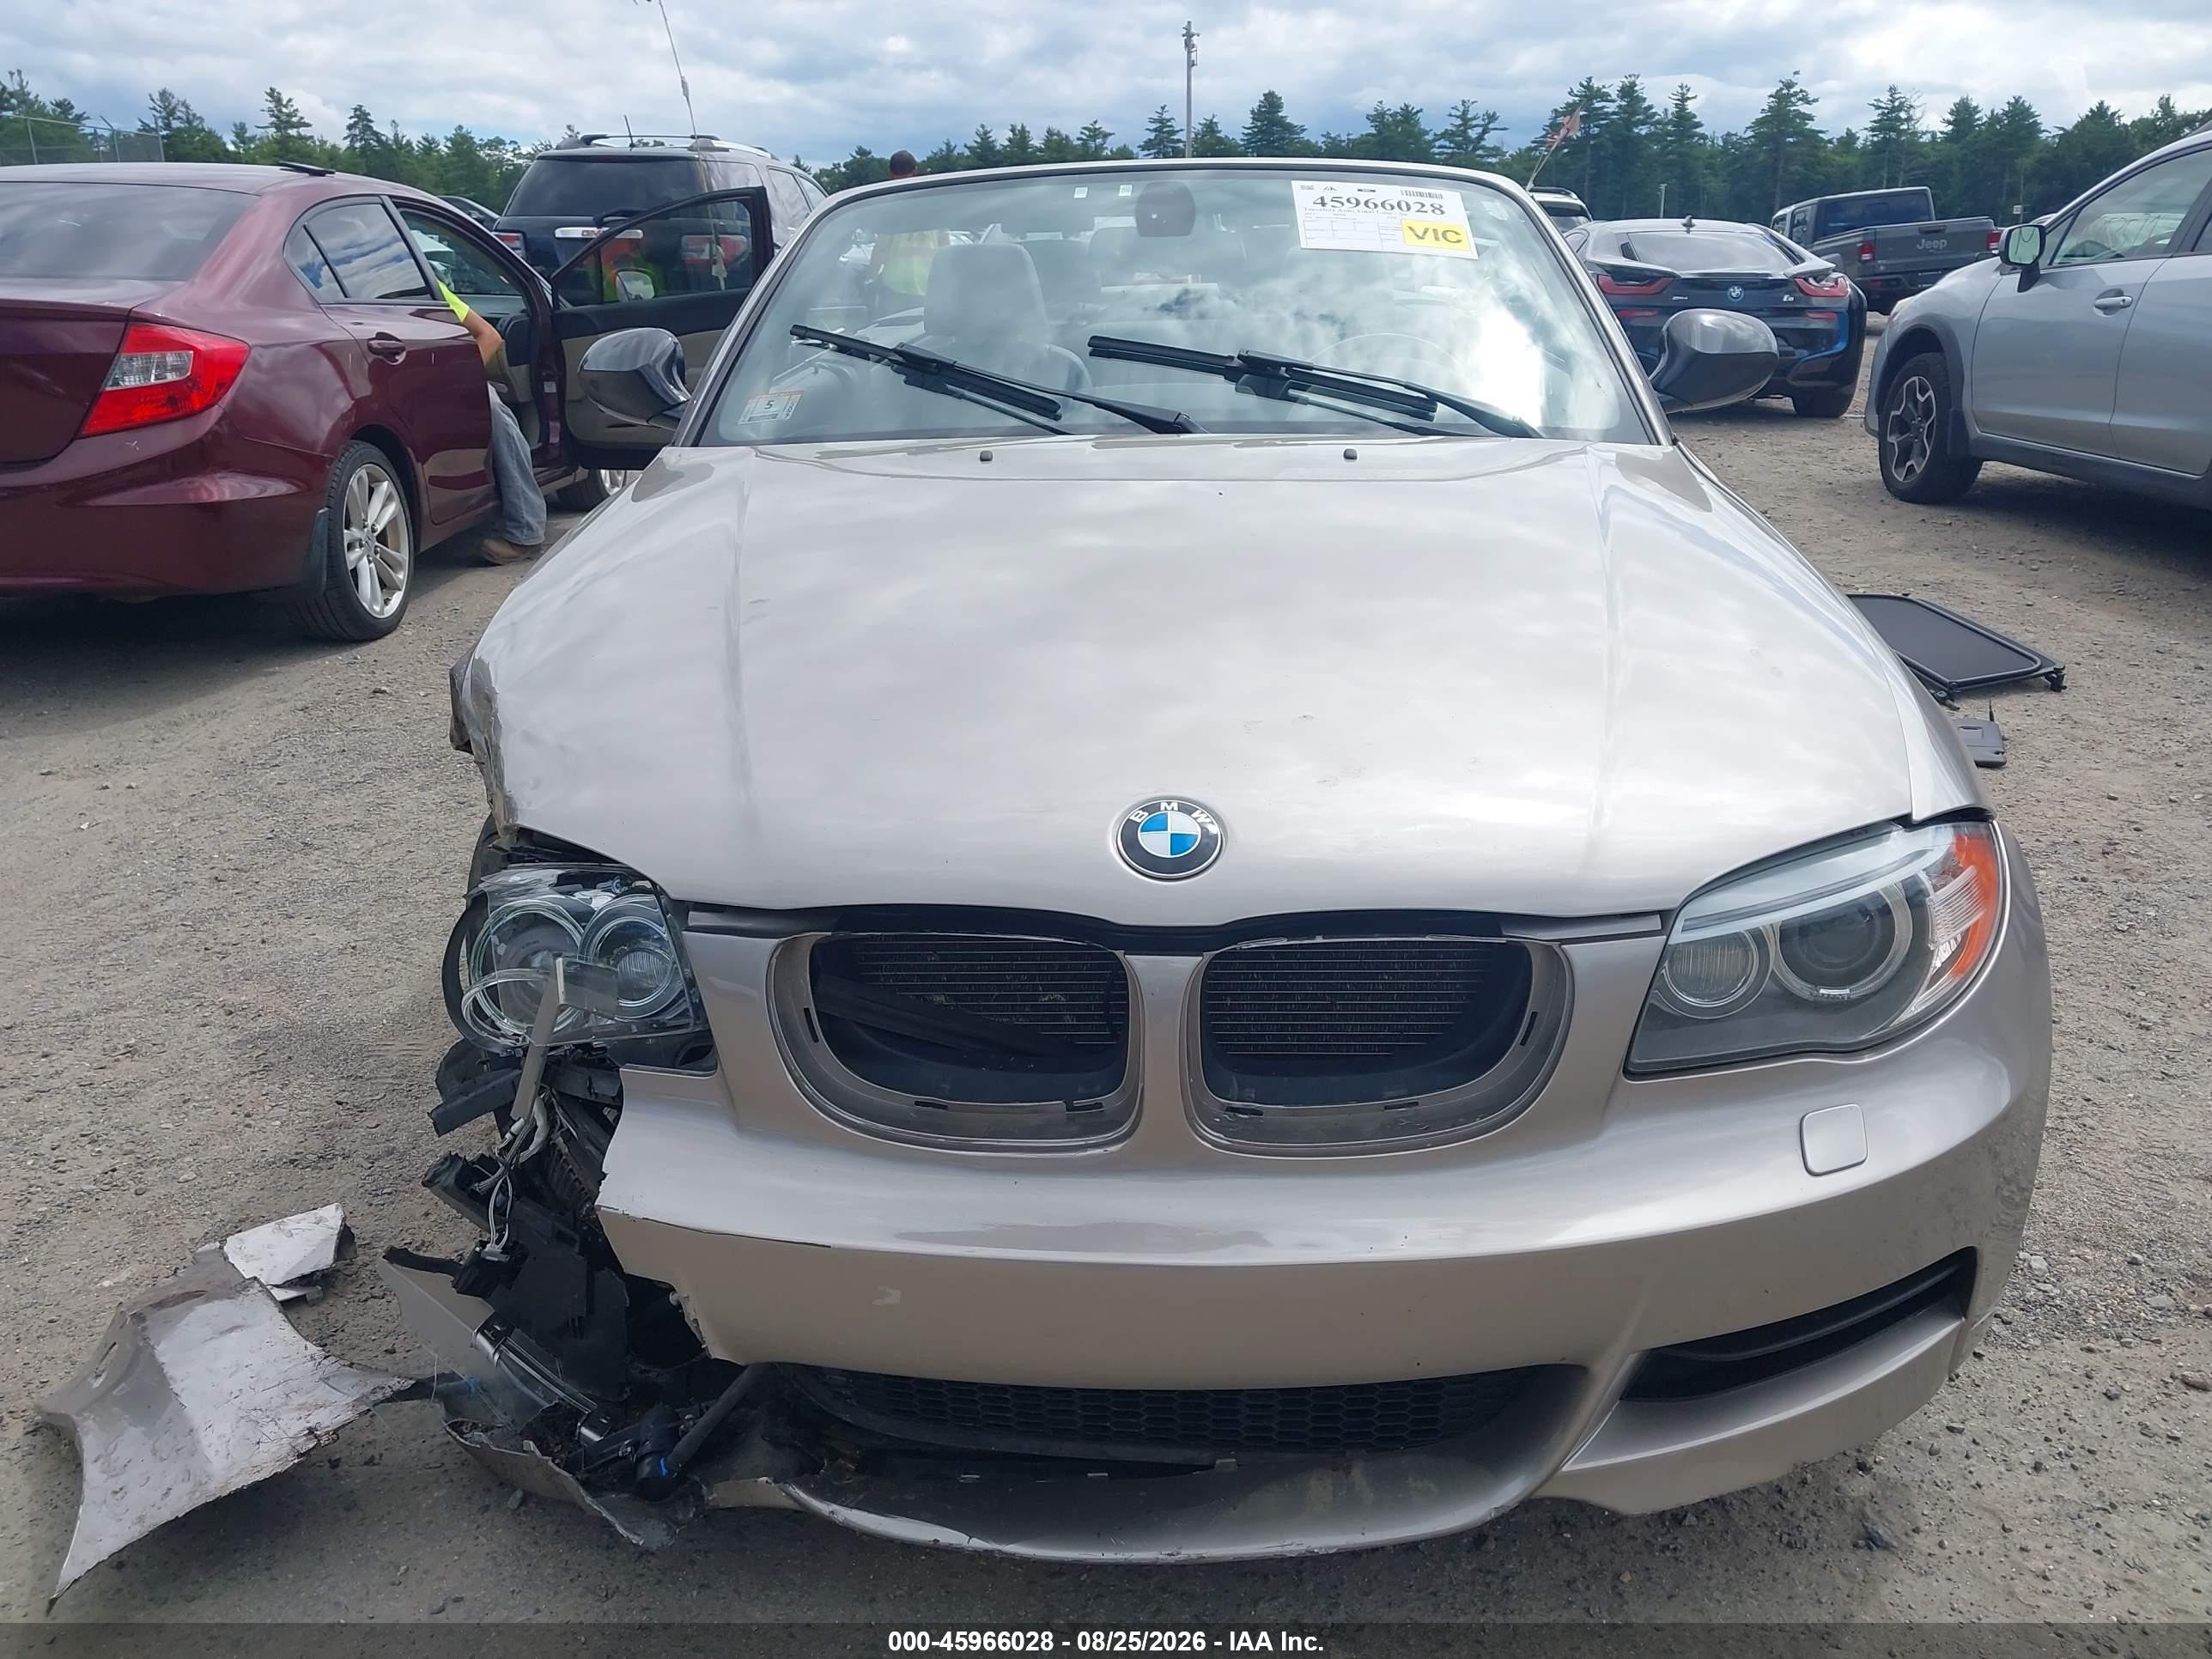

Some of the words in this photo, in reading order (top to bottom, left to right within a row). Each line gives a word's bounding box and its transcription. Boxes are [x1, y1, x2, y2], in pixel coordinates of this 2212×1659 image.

[1312, 195, 1446, 216] 45966028
[1407, 225, 1463, 245] VIC
[1916, 238, 1948, 251] Jeep
[763, 399, 775, 410] 5
[1127, 800, 1219, 834] BMW
